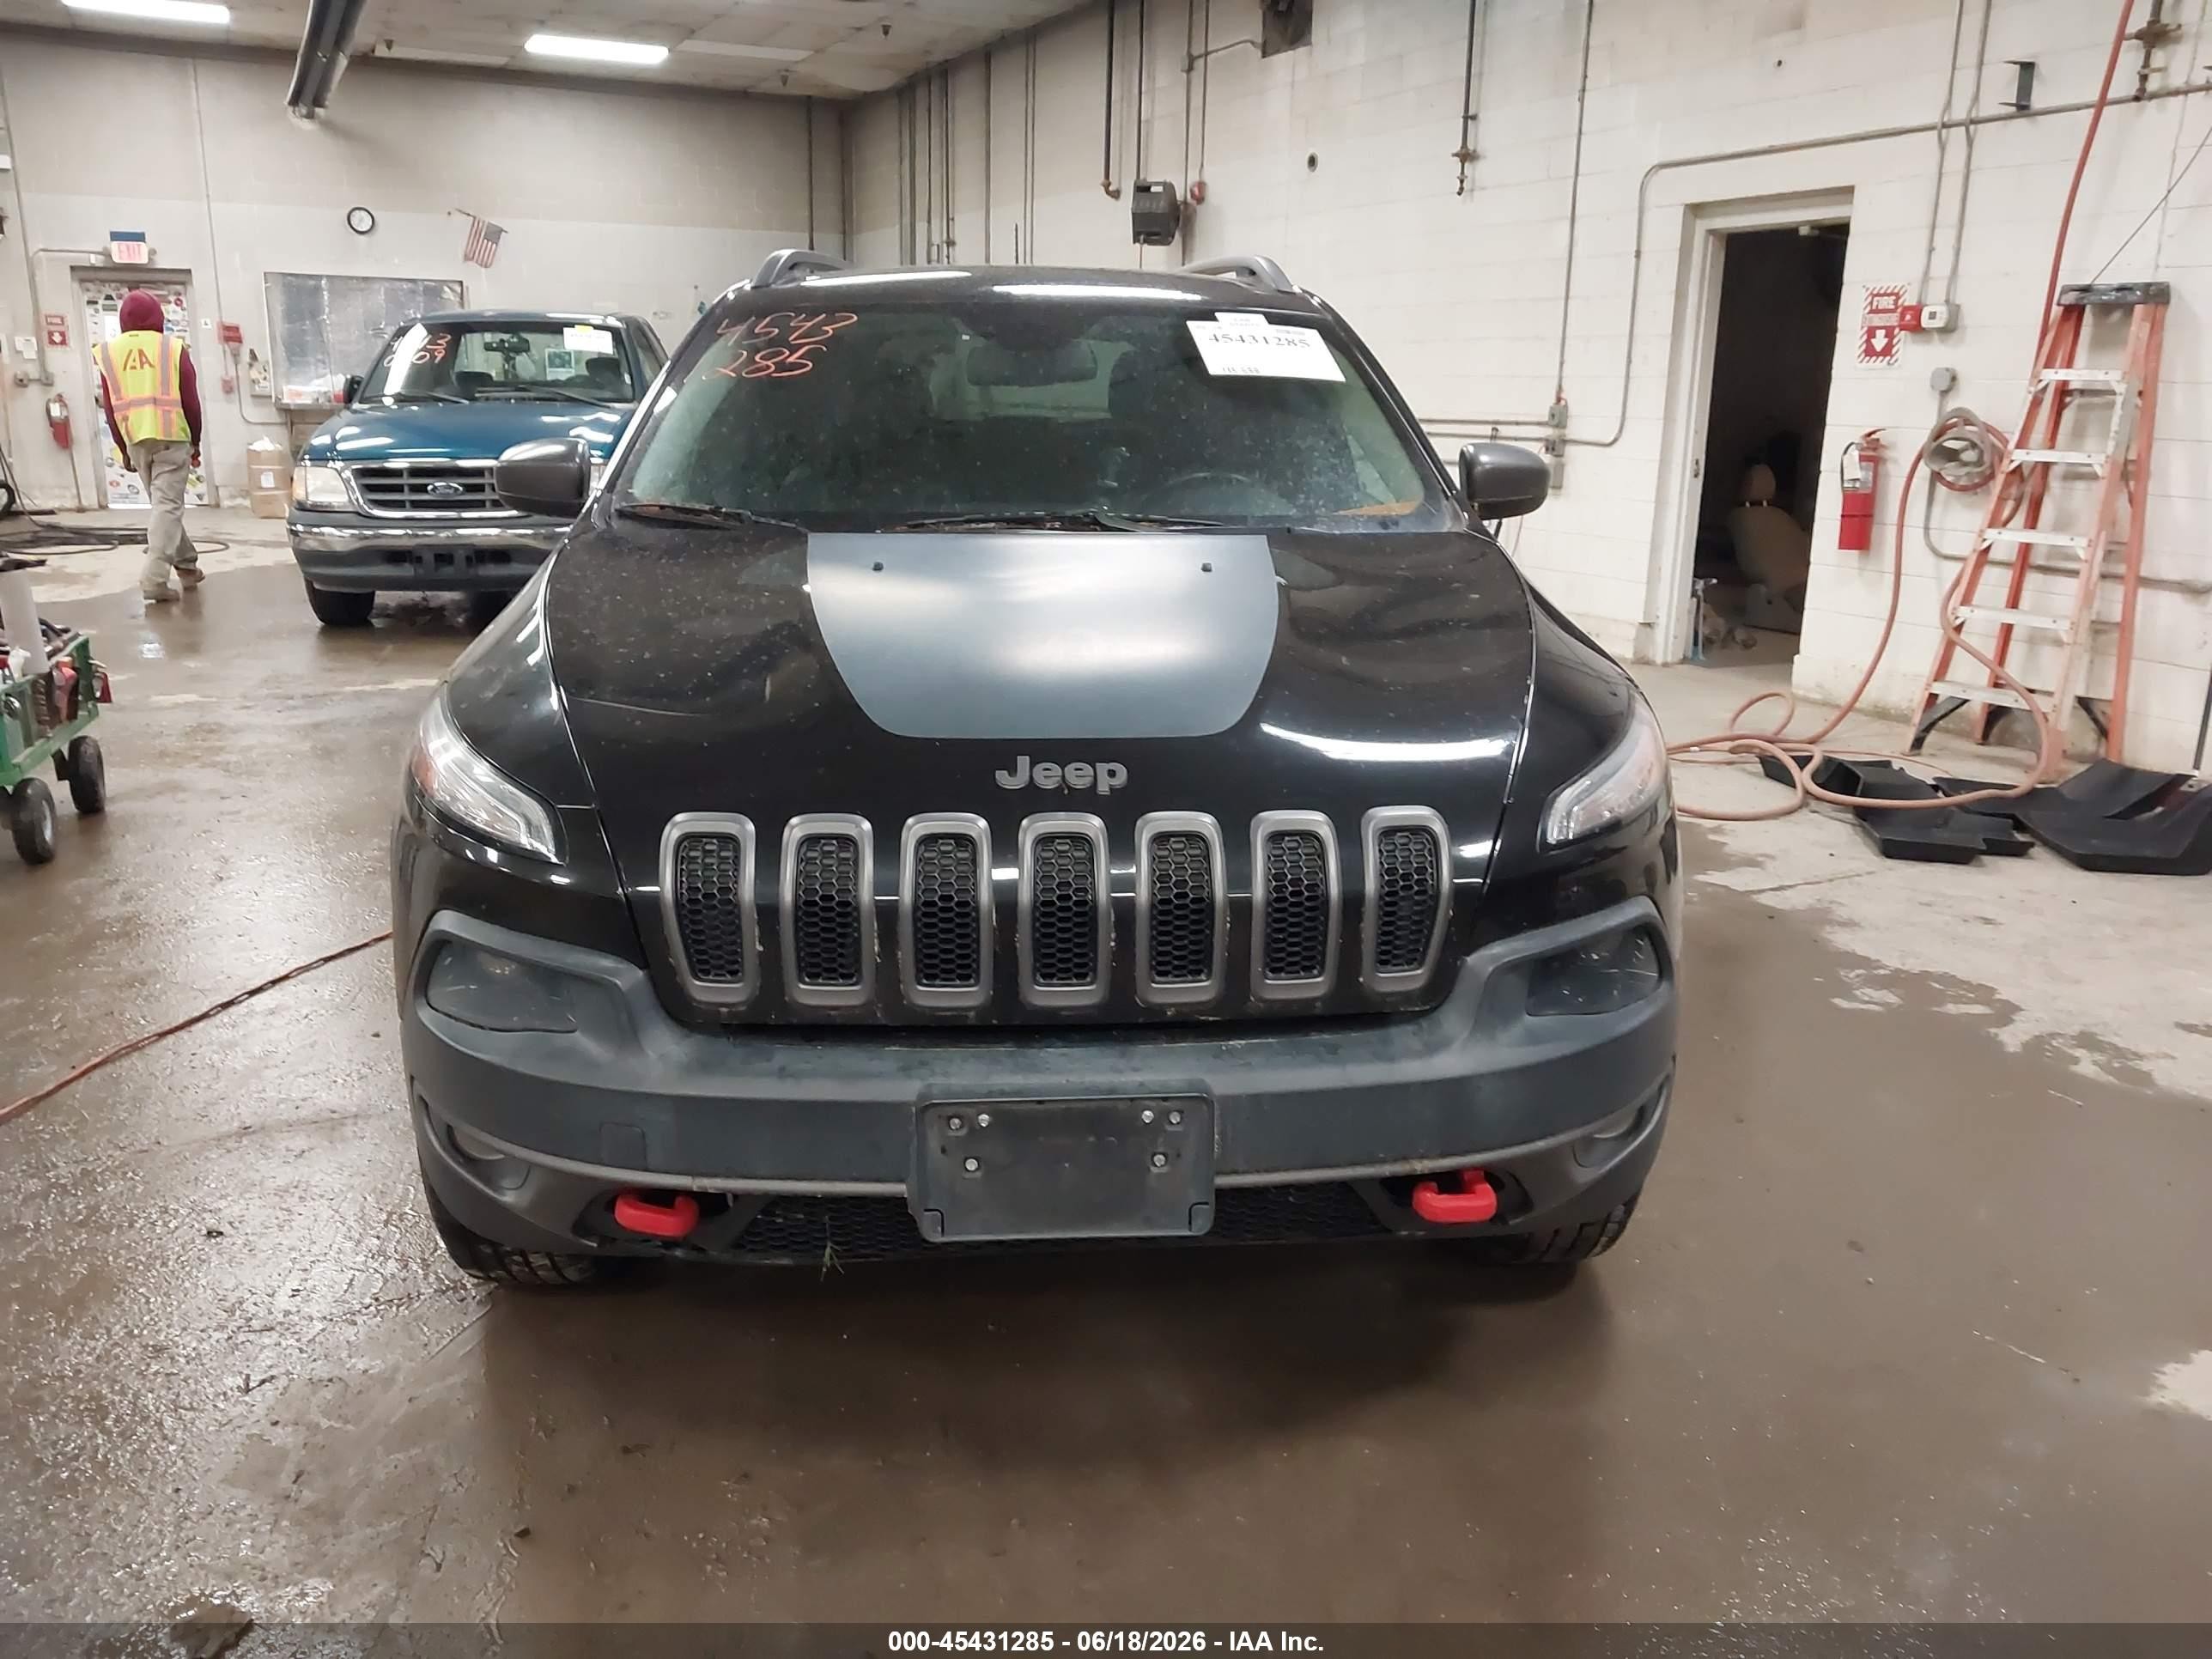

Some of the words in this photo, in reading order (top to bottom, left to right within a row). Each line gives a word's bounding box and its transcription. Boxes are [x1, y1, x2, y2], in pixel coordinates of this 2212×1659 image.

[117, 243, 142, 261] EXIT
[716, 312, 859, 346] 4543
[1208, 332, 1311, 349] 45431285
[995, 755, 1128, 795] Jeep
